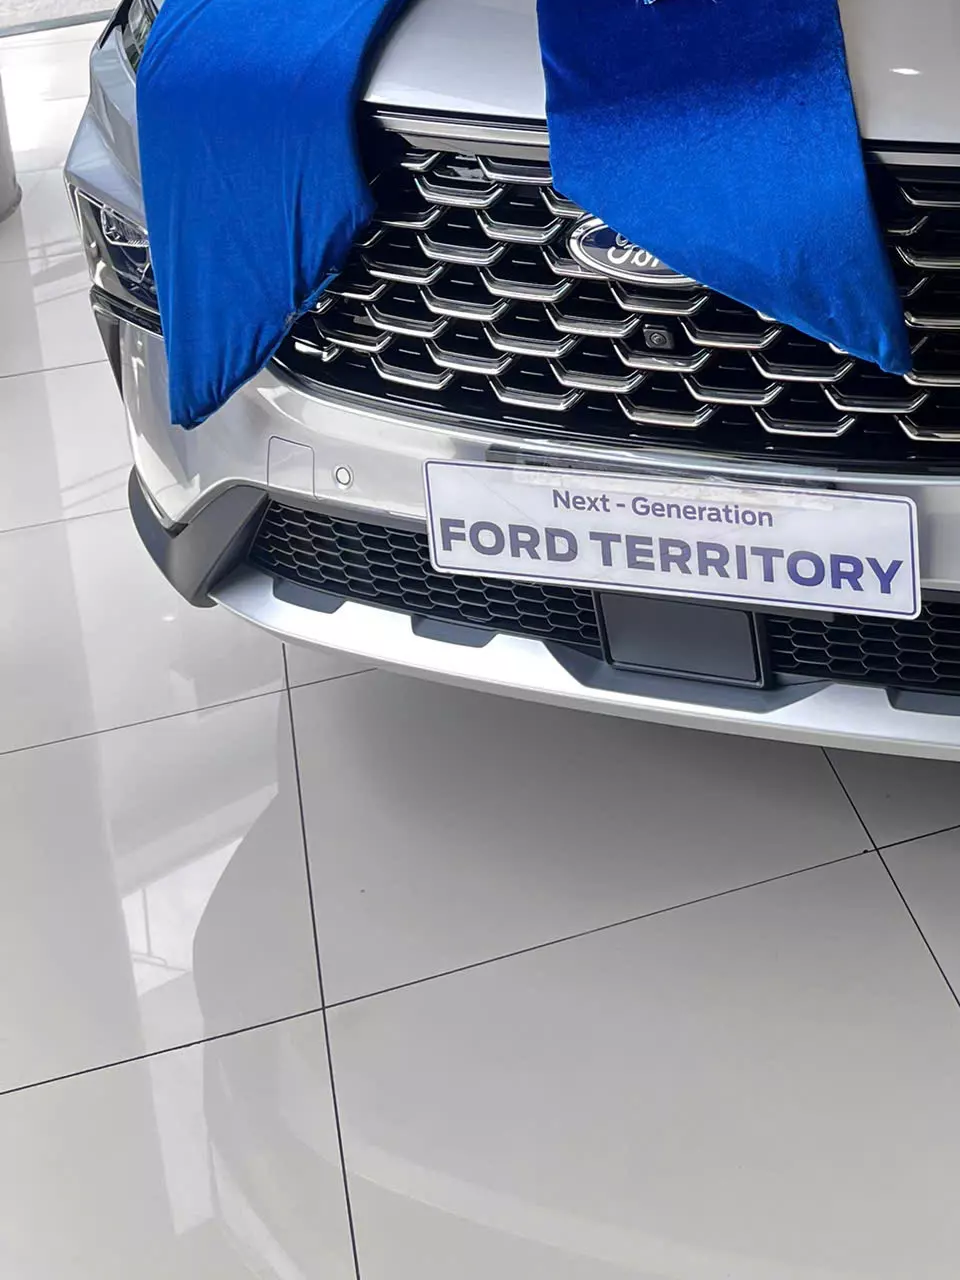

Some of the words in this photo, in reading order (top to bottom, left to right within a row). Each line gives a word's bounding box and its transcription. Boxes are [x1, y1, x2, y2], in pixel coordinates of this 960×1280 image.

[552, 489, 611, 513] Next
[631, 496, 773, 528] Generation
[440, 517, 578, 563] FORD
[590, 531, 904, 595] TERRITORY
